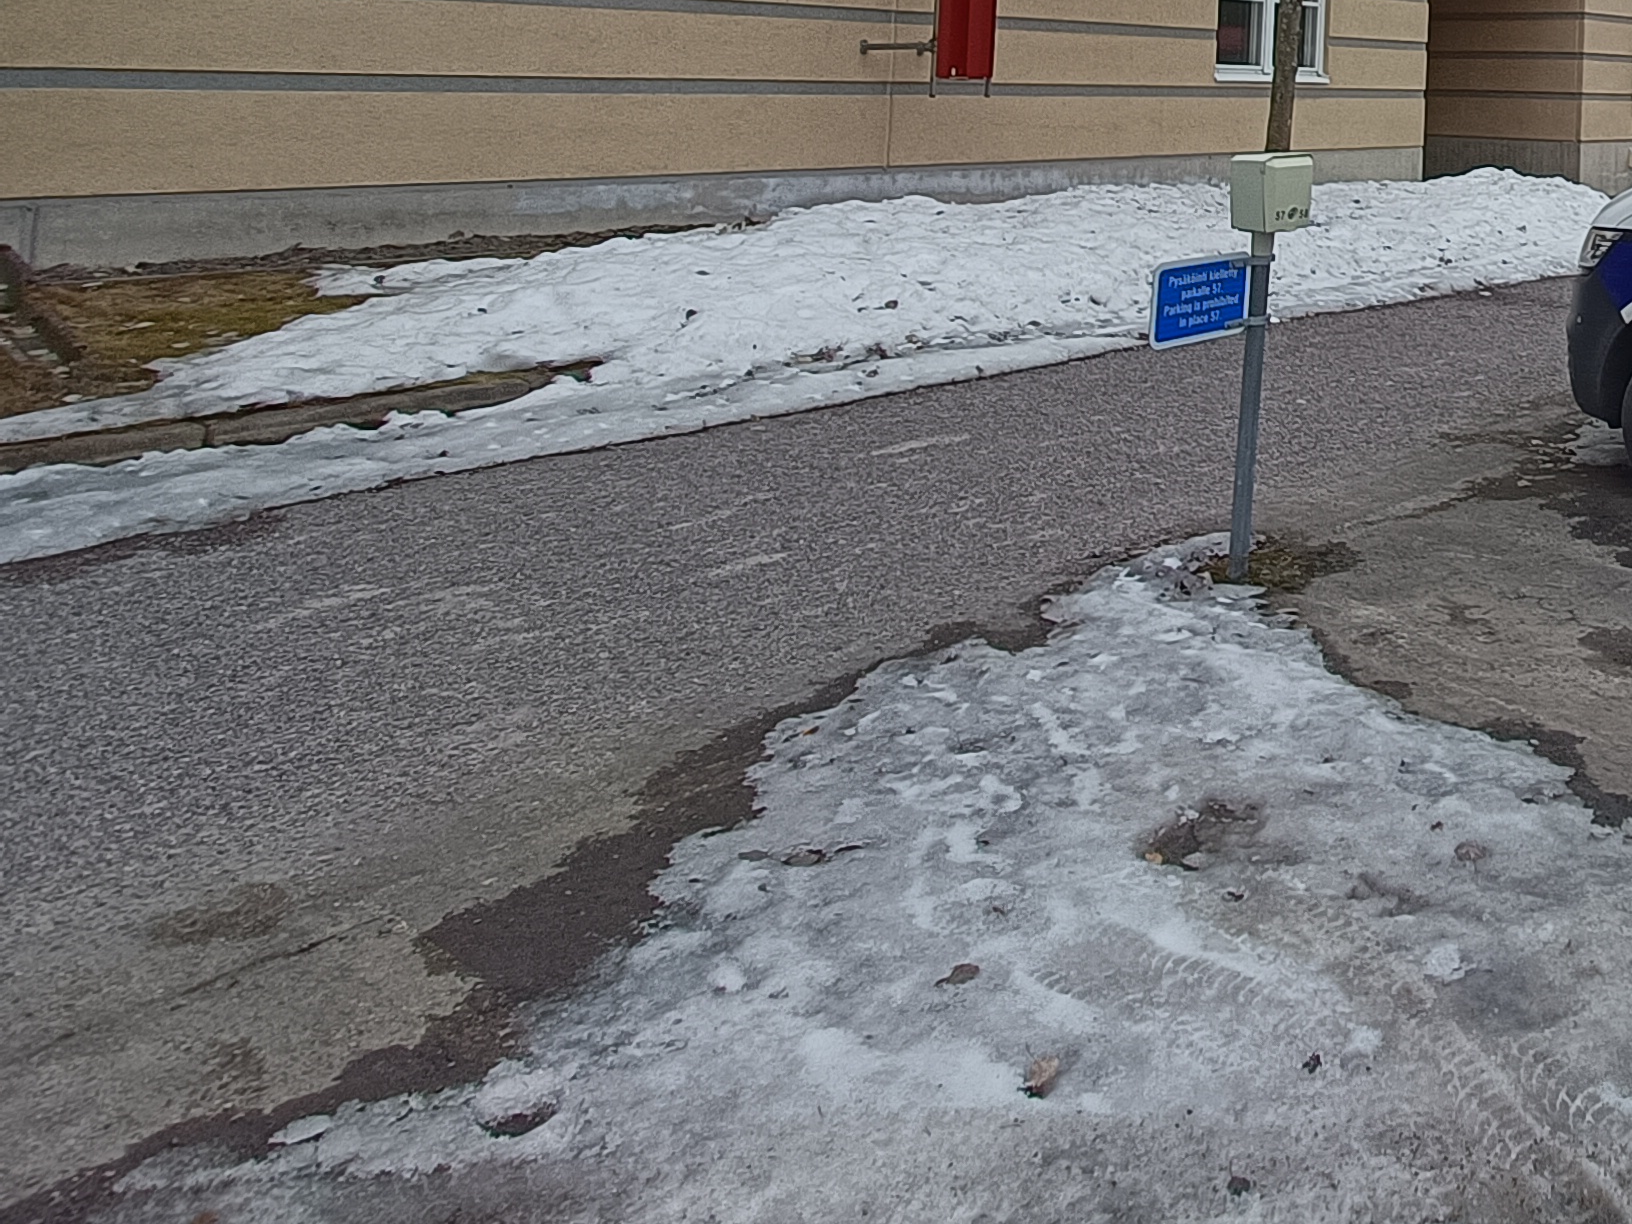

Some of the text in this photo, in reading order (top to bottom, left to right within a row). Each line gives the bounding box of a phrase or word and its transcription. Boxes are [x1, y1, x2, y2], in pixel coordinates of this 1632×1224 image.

[1275, 210, 1286, 221] 57
[1163, 294, 1239, 317] Parking is prohibited
[1179, 317, 1187, 328] in
[1188, 314, 1208, 328] place
